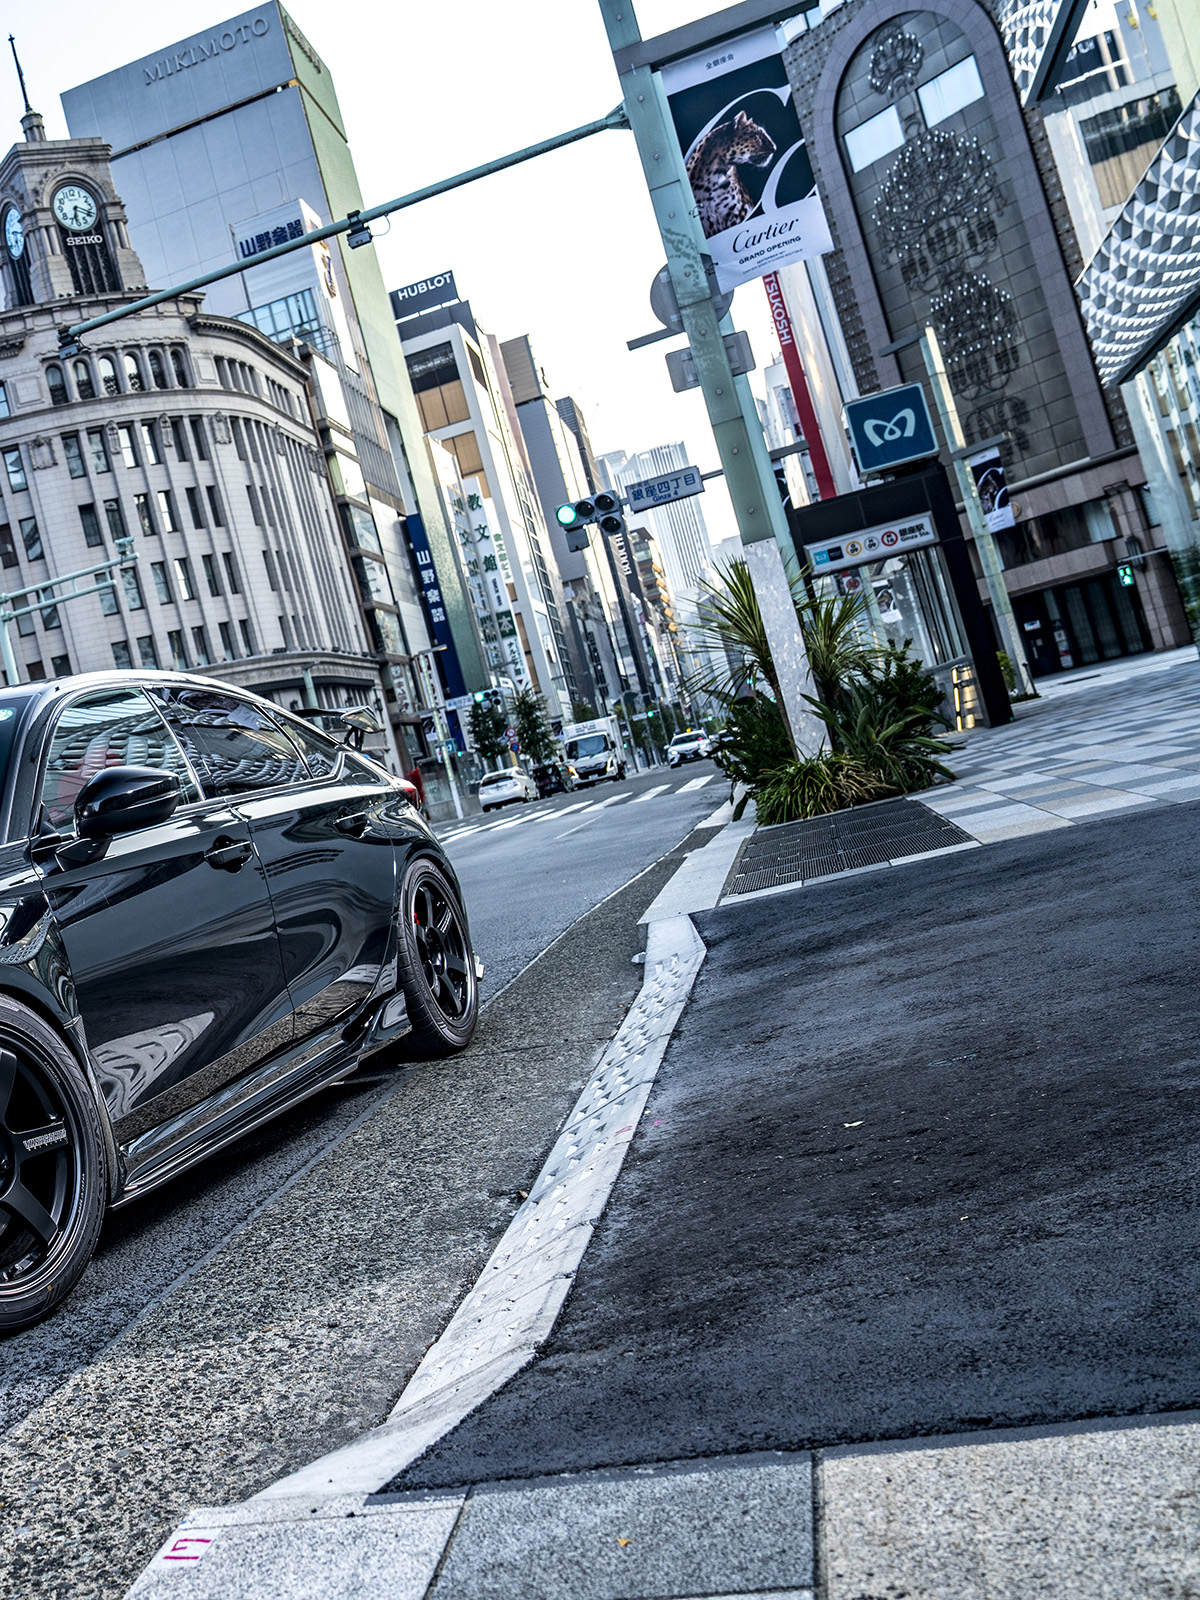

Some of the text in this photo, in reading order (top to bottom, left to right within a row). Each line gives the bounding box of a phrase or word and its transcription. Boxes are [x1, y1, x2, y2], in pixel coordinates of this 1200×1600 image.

[143, 18, 269, 86] MIKIMOTO
[66, 235, 103, 246] SEIKO
[732, 219, 799, 253] Cartier
[738, 248, 765, 265] GRAND
[766, 236, 802, 253] OPENING
[397, 272, 451, 301] HUBLOT
[631, 473, 696, 501] 銀座四丁目
[652, 493, 672, 502] Ginza
[467, 493, 490, 573] 教文館
[416, 549, 445, 623] 山野楽器
